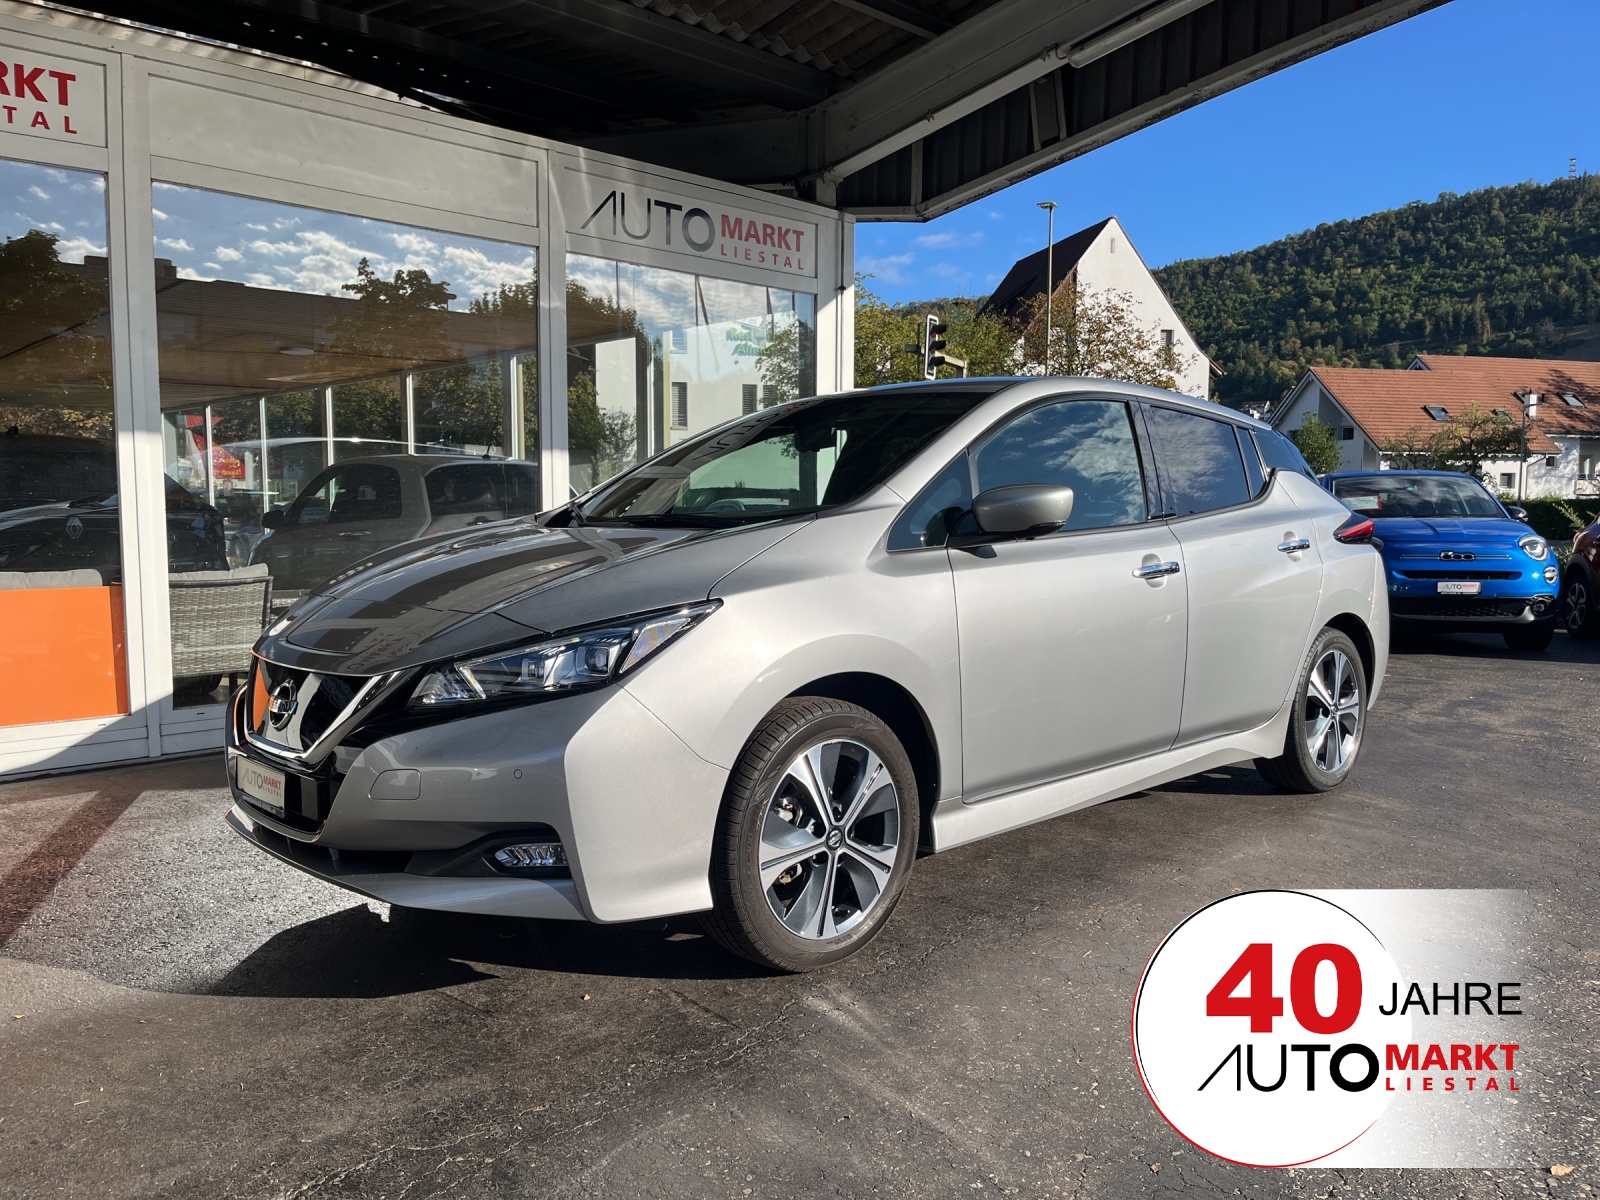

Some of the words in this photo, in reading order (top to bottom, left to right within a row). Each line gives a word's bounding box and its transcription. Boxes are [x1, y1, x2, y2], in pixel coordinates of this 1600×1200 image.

[2, 105, 77, 134] TAL
[580, 190, 715, 252] AUTO
[721, 214, 804, 252] MARKT
[721, 243, 804, 270] LIESTAL
[242, 768, 263, 789] AUTO
[263, 775, 282, 790] MARKT
